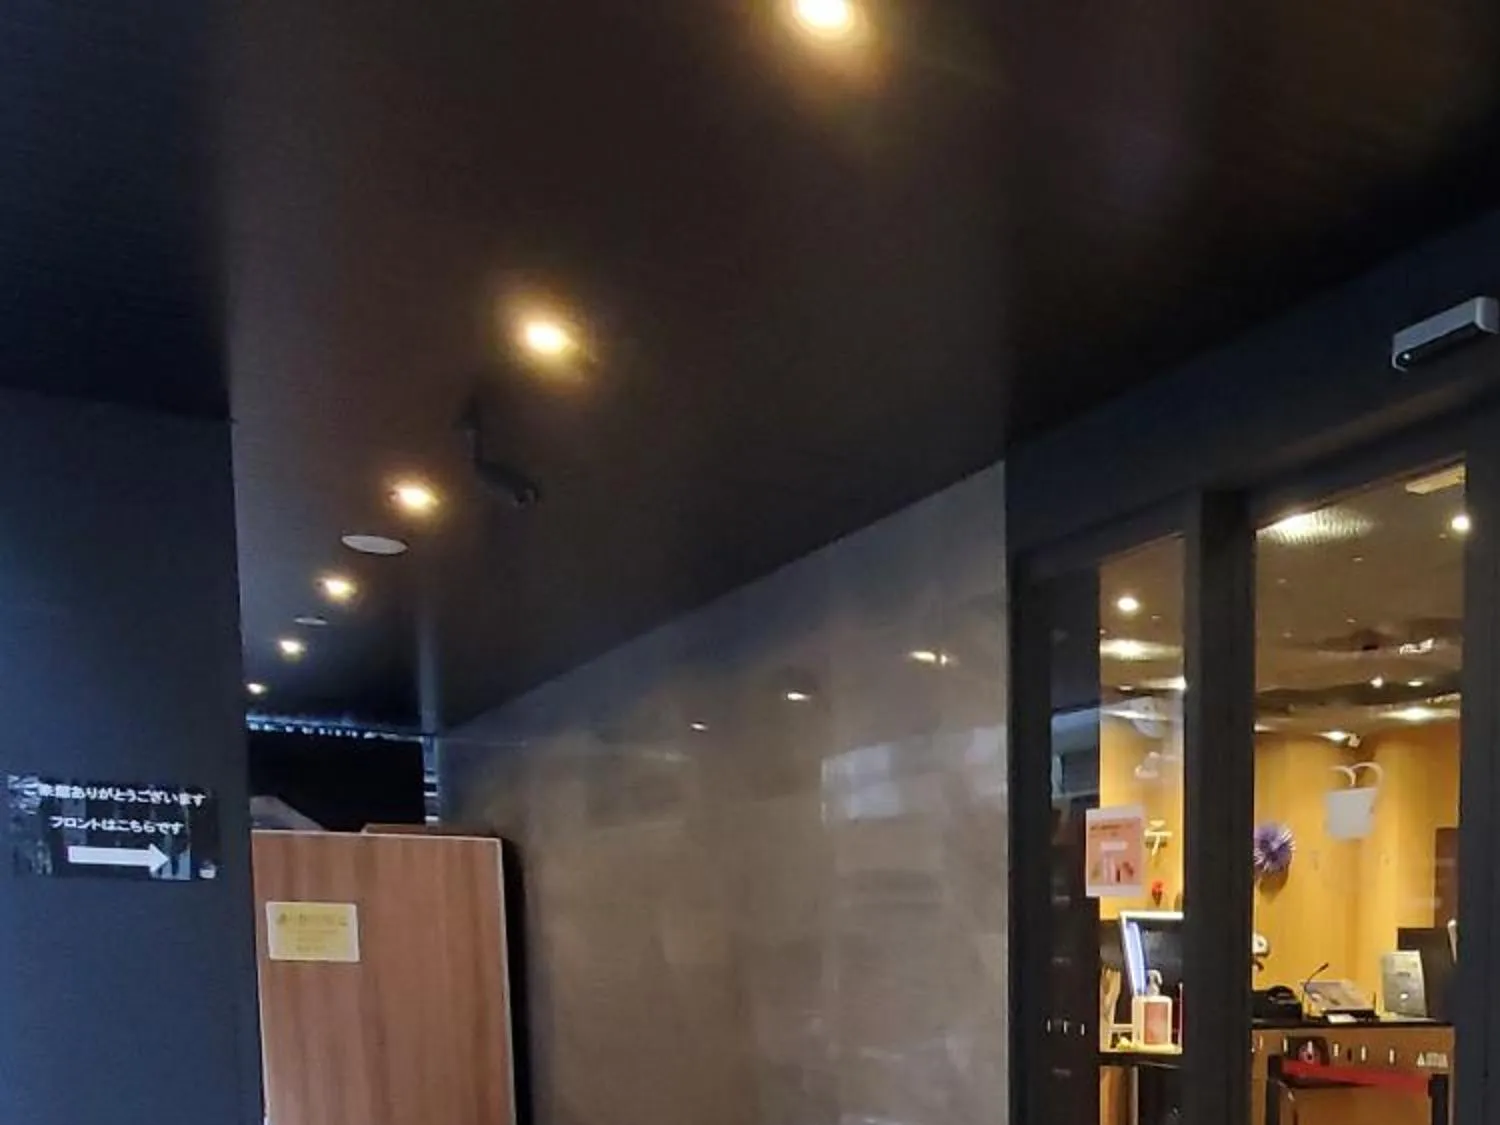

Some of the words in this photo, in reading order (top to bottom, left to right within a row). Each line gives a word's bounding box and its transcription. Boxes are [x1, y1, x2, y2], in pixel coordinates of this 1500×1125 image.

[48, 816, 185, 835] フロントはこちらです
